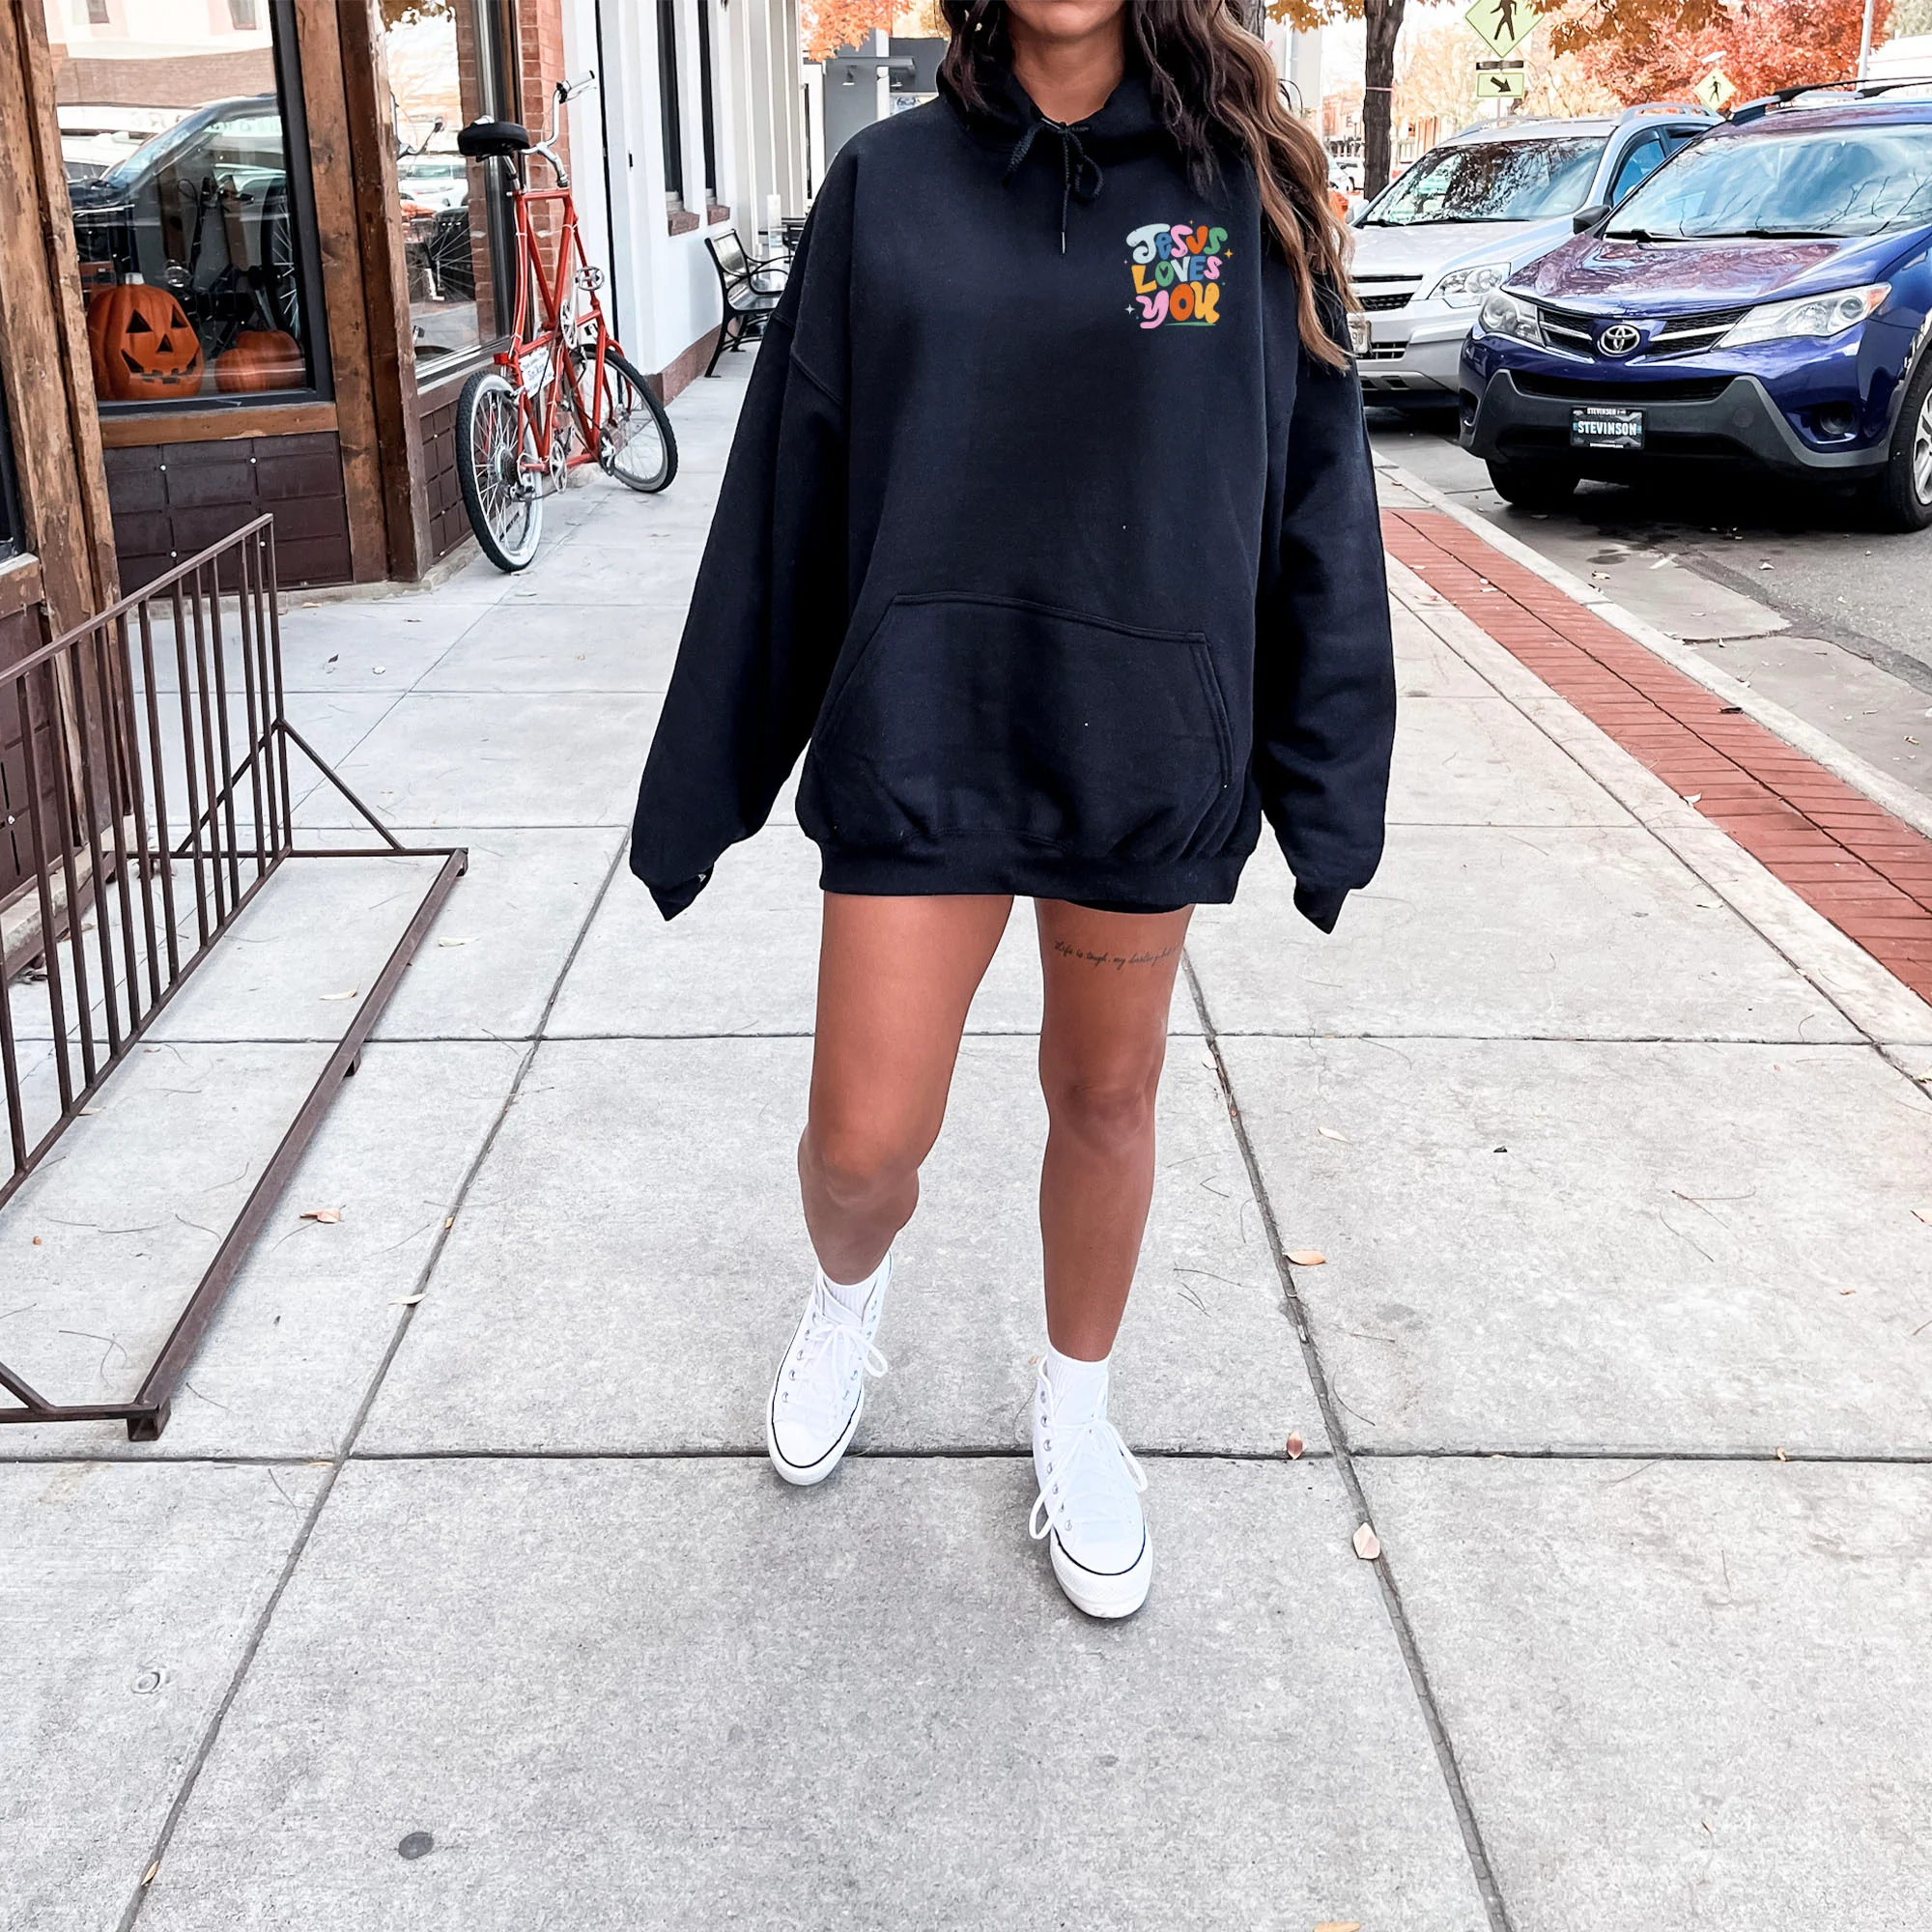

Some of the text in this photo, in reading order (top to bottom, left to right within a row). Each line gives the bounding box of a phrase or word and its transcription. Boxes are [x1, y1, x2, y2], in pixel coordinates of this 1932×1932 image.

[1131, 255, 1222, 294] LOVES
[1587, 407, 1616, 415] STEVINSON
[1577, 420, 1637, 436] STEVINSON
